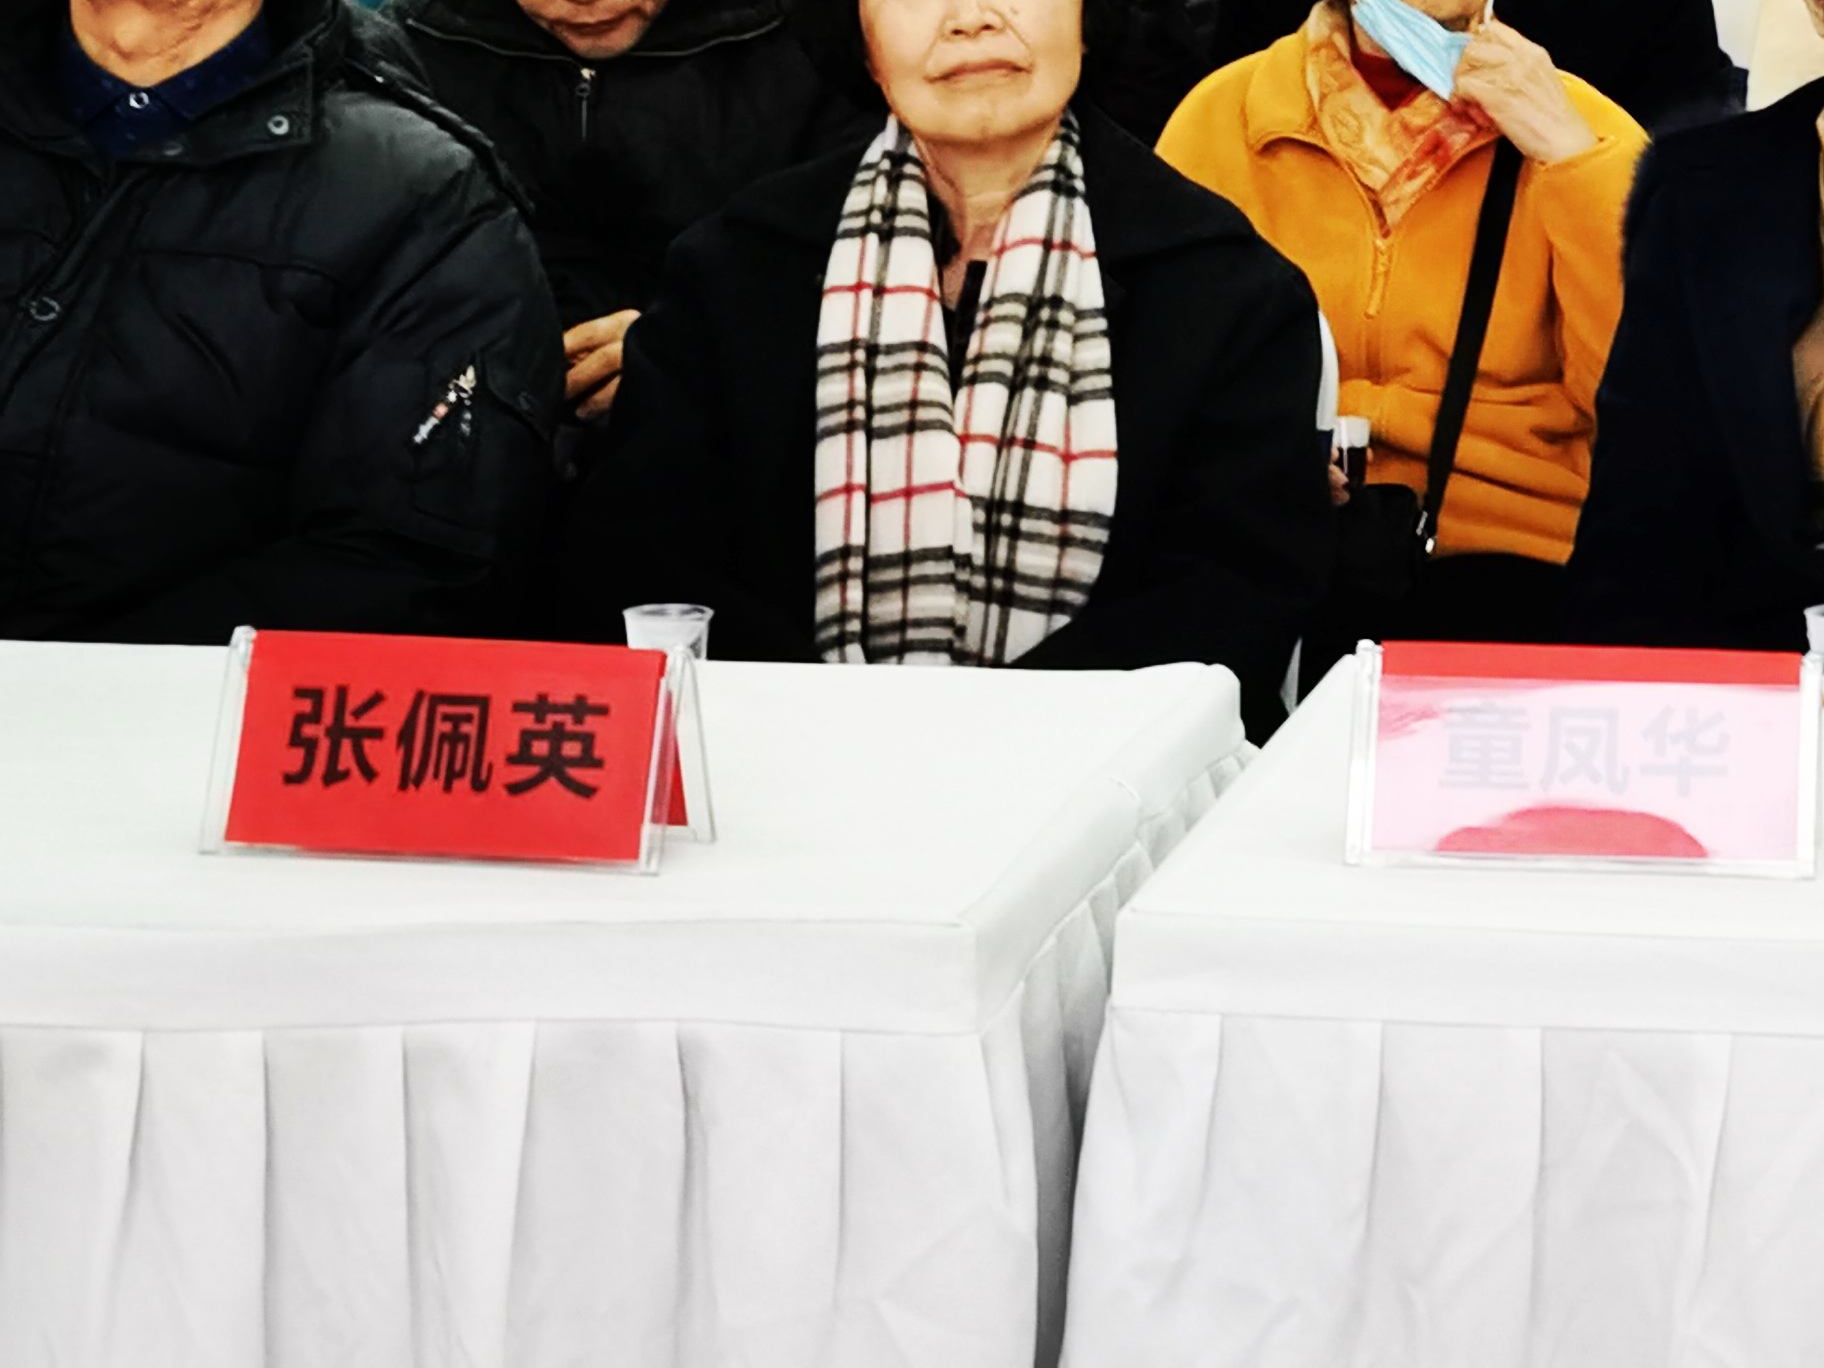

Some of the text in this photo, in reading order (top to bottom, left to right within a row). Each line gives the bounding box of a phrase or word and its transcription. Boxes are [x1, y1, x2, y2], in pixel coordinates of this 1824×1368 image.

[281, 683, 610, 800] 张佩英
[1436, 700, 1732, 798] 童凤华
